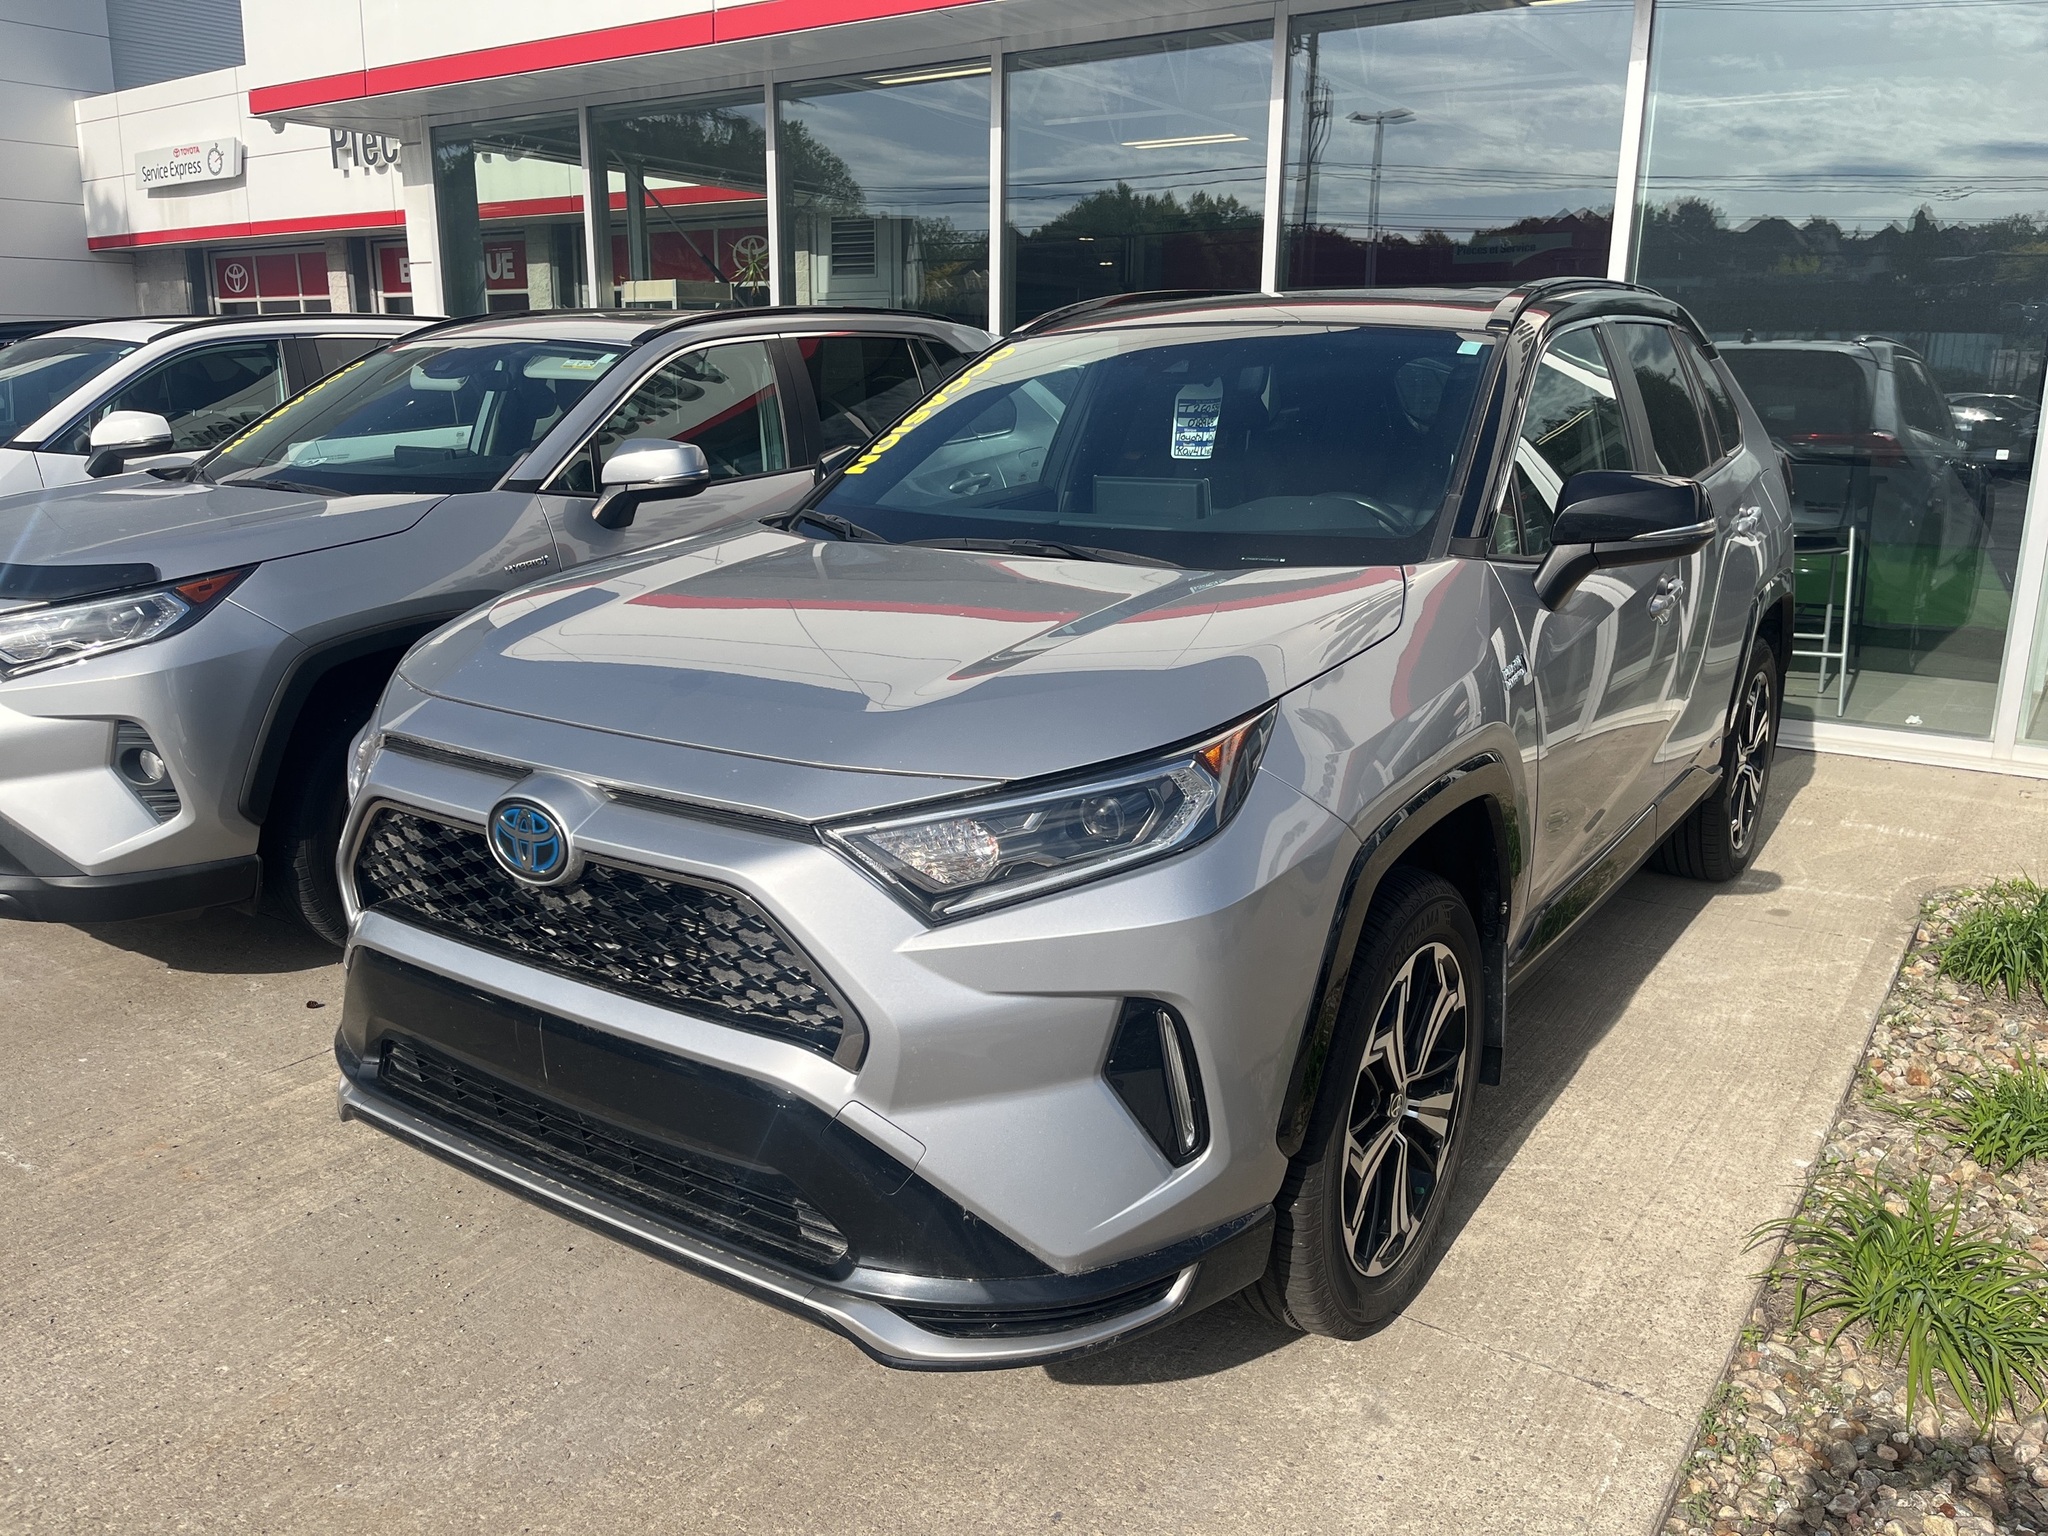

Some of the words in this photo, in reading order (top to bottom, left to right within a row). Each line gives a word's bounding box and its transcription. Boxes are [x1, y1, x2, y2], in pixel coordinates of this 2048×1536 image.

[180, 146, 201, 156] TOYOTA
[141, 163, 168, 182] Service
[169, 160, 202, 180] Express
[1501, 243, 1536, 254] Service
[843, 347, 1016, 475] OCCASION
[1387, 908, 1440, 976] YOKOHAMA
